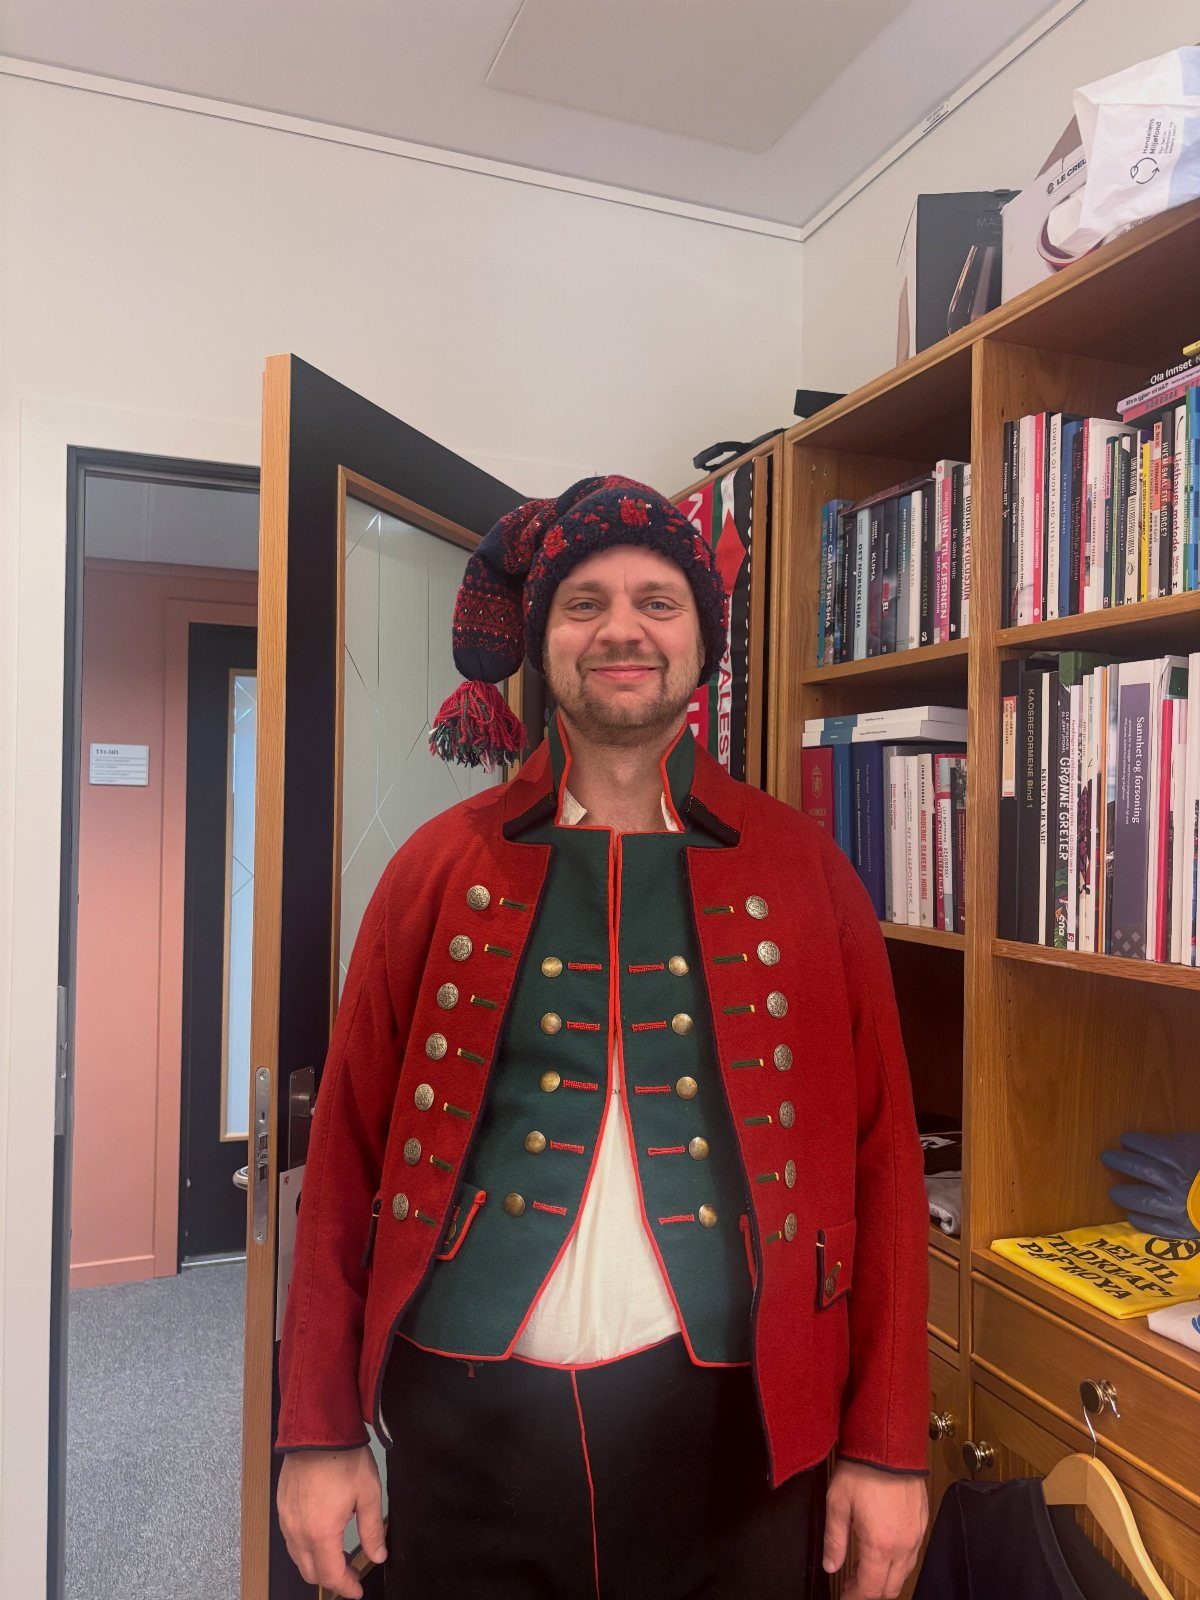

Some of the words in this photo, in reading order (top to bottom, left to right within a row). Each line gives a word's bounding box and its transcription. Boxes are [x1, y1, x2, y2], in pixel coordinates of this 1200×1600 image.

[1056, 174, 1066, 186] LE
[1150, 373, 1164, 384] Ola
[1165, 359, 1192, 377] Innset
[1050, 459, 1058, 471] OF
[1050, 473, 1058, 497] IVORY
[1160, 506, 1168, 537] NORGE?
[1172, 509, 1180, 552] metode
[825, 544, 834, 589] CAMPUS
[940, 563, 948, 618] KJERNEN
[1027, 688, 1036, 778] KAOSREFORMENE
[1136, 716, 1145, 758] Sannhet
[1133, 760, 1142, 773] og
[1026, 780, 1034, 802] Bind
[1059, 757, 1070, 808] GRØNNE
[1040, 808, 1046, 820] ER
[1132, 775, 1144, 824] forsoning
[907, 827, 912, 838] NY
[1059, 812, 1069, 860] GREIER
[920, 844, 928, 872] SLAVERI
[1082, 1238, 1140, 1262] NEI
[1132, 1258, 1179, 1285] TIL
